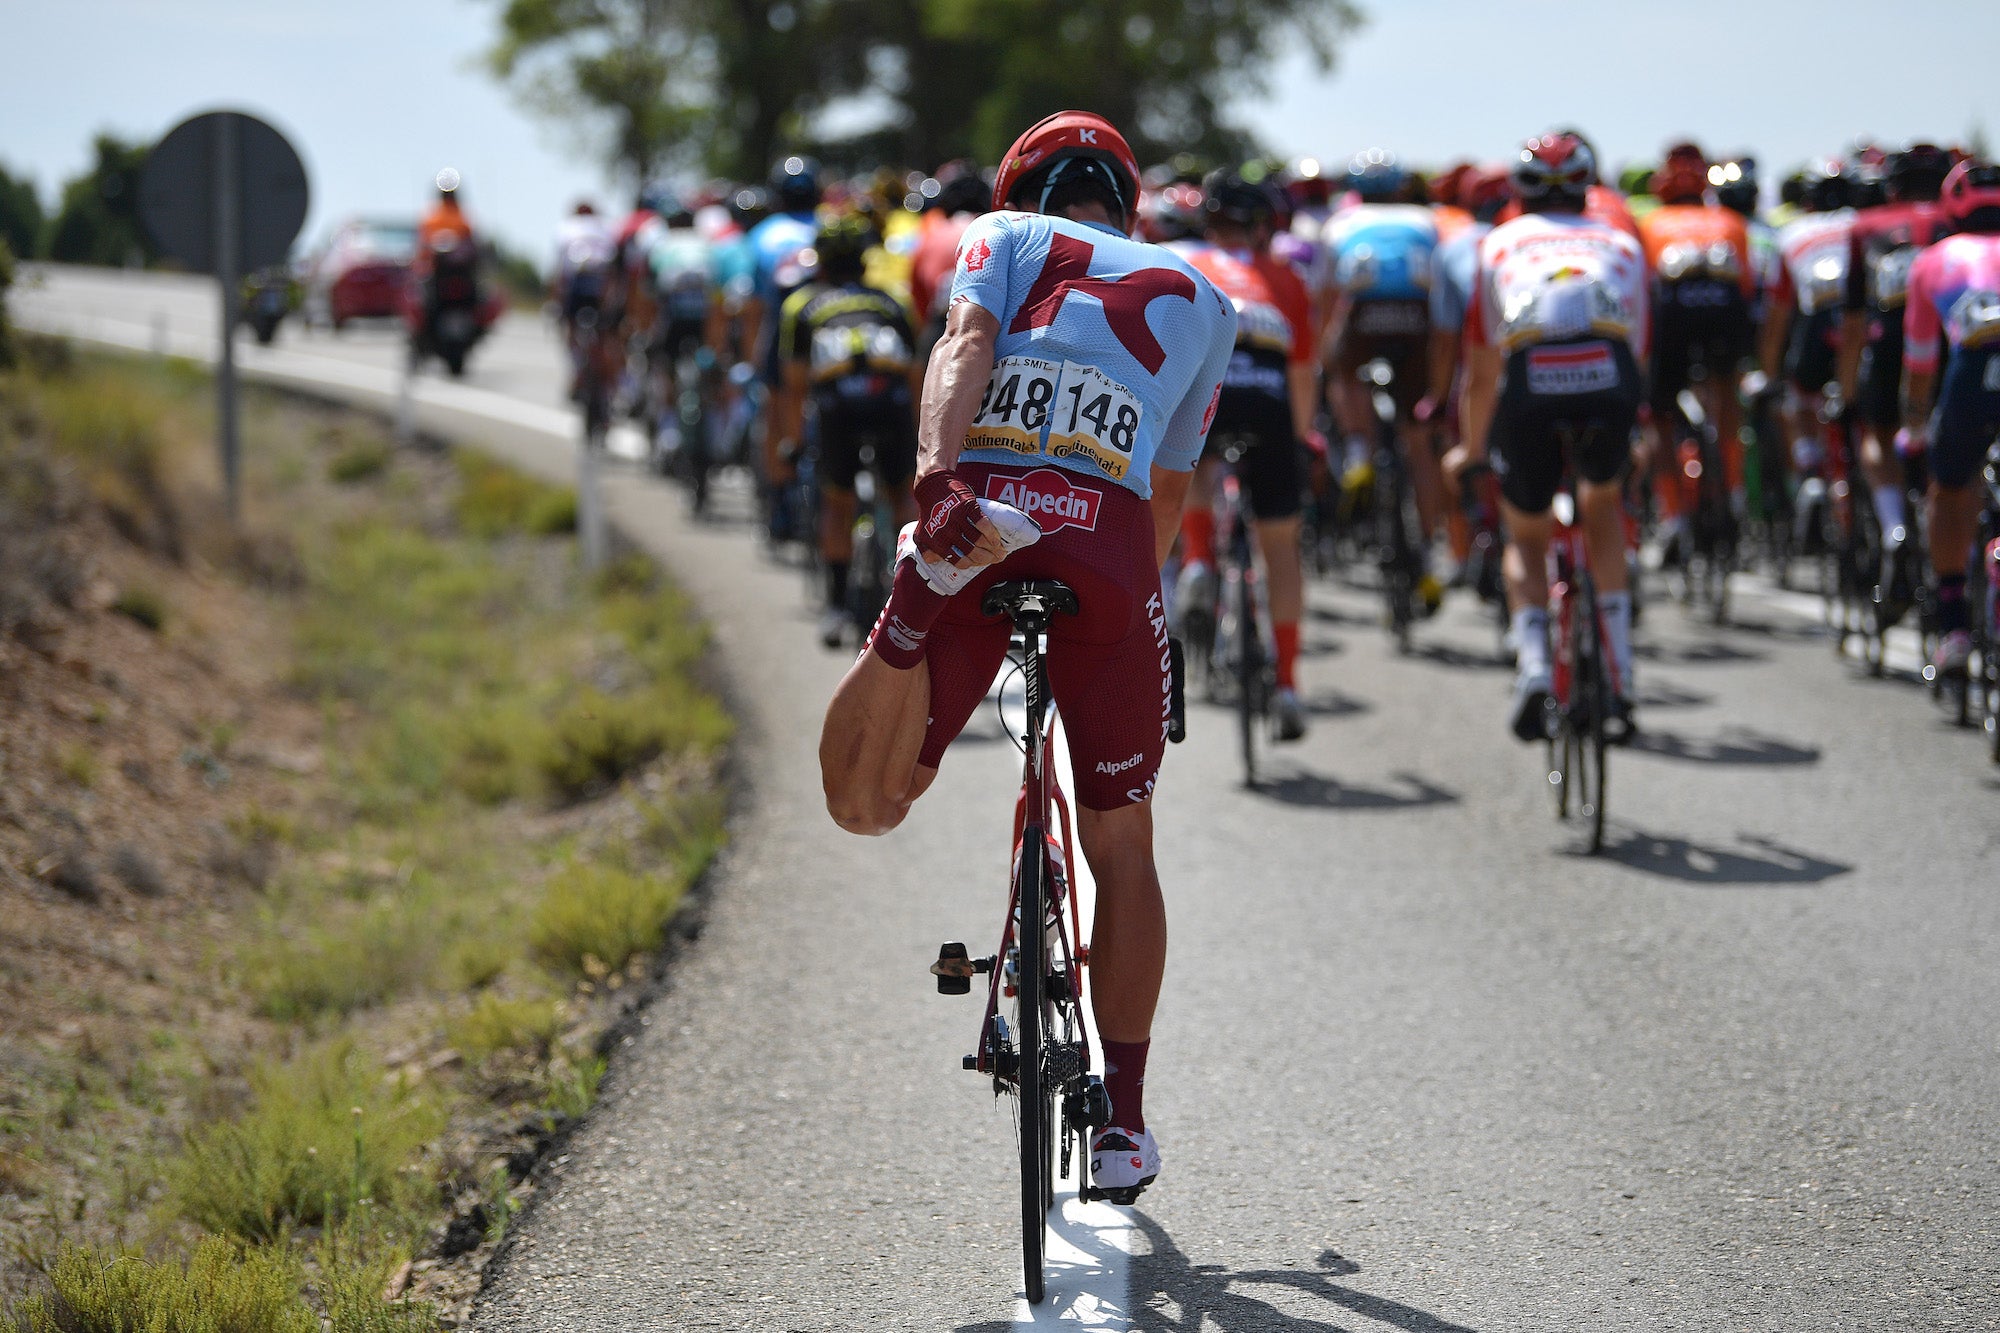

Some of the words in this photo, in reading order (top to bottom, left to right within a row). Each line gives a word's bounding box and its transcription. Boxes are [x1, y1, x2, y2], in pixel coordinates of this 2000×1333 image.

[1079, 128, 1098, 144] K
[1023, 358, 1049, 370] SMIT
[1068, 382, 1139, 453] 148
[929, 499, 955, 531] Alpecin
[998, 482, 1089, 521] Alpecin
[1027, 649, 1038, 707] CANYON
[1146, 592, 1172, 742] KATUSHA
[1095, 752, 1143, 776] Alpecin
